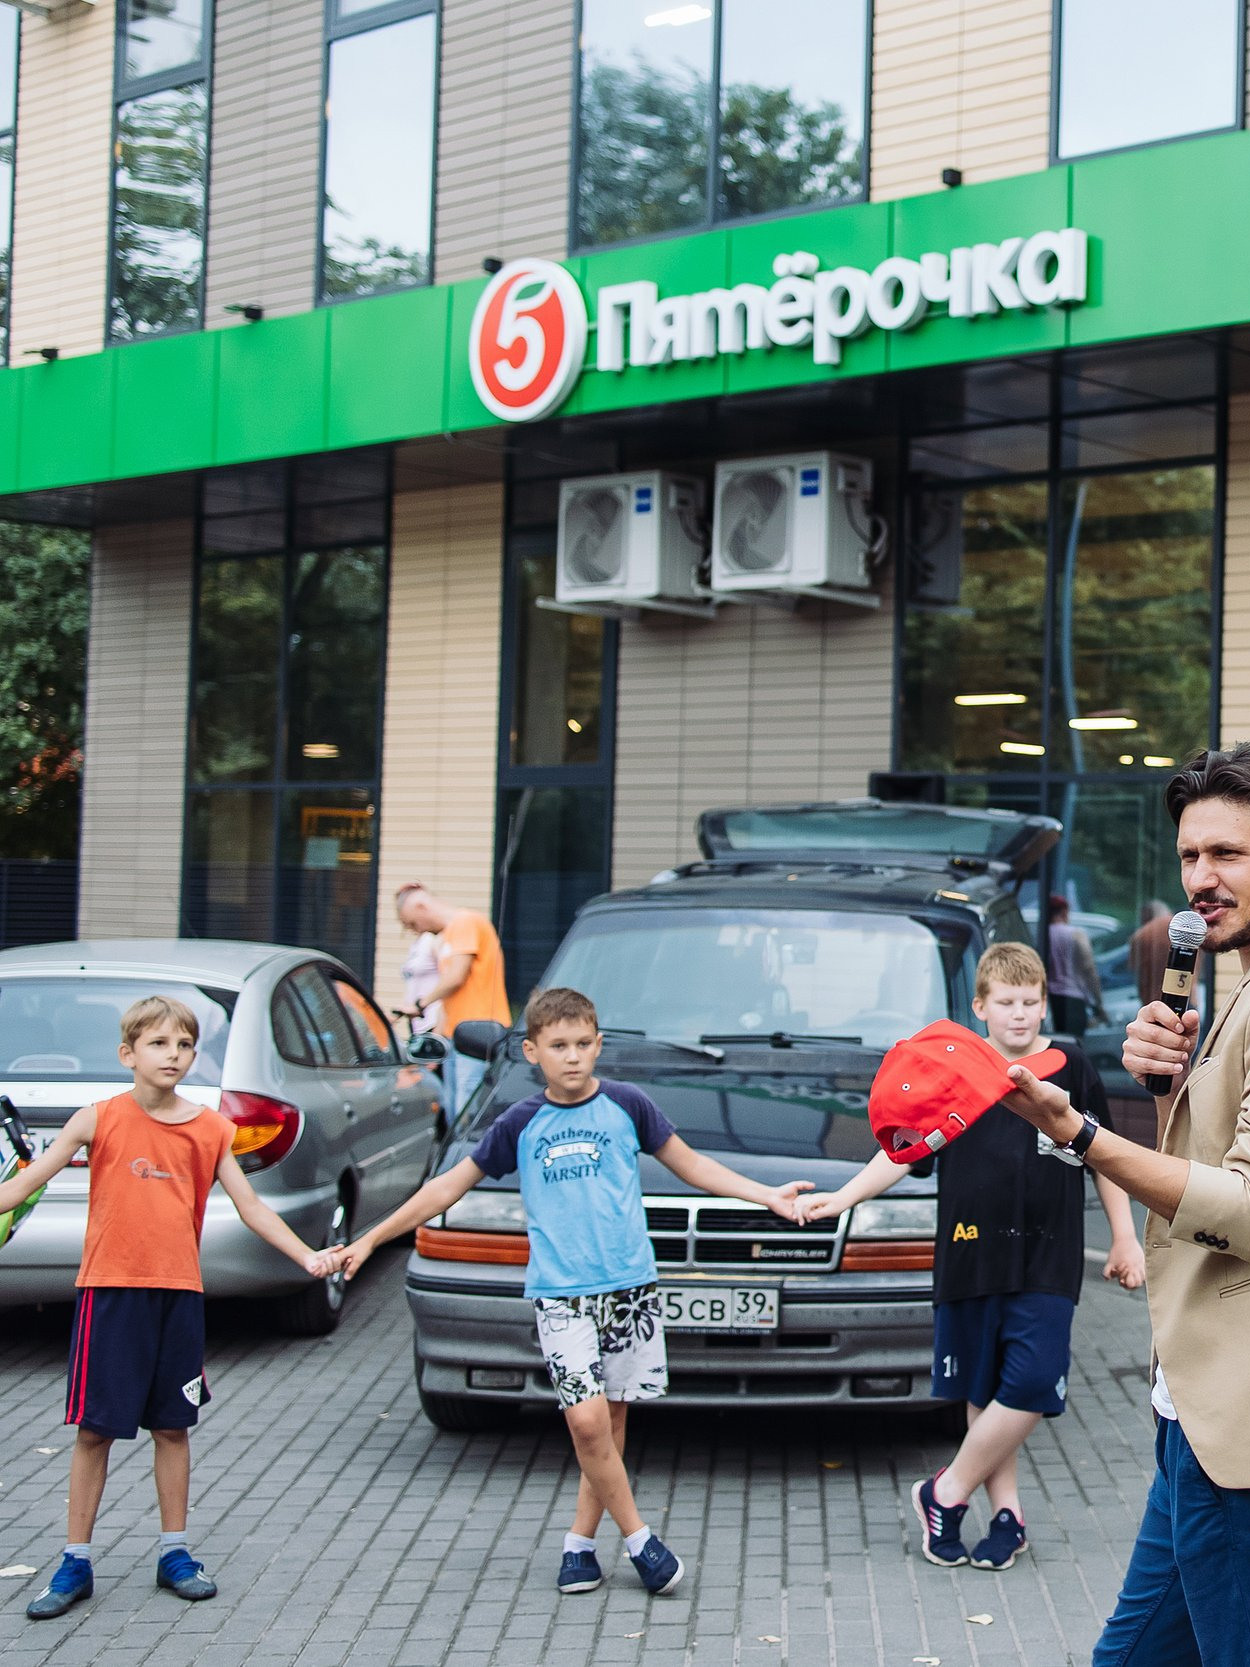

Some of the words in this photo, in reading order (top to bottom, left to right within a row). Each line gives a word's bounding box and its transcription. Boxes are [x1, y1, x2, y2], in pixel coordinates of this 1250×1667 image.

[494, 272, 554, 392] 5
[597, 228, 1089, 372] Пятёрочка
[534, 1127, 611, 1160] Authentic
[542, 1164, 601, 1185] VARSITY
[952, 1222, 979, 1242] Aa
[737, 1292, 766, 1315] 39
